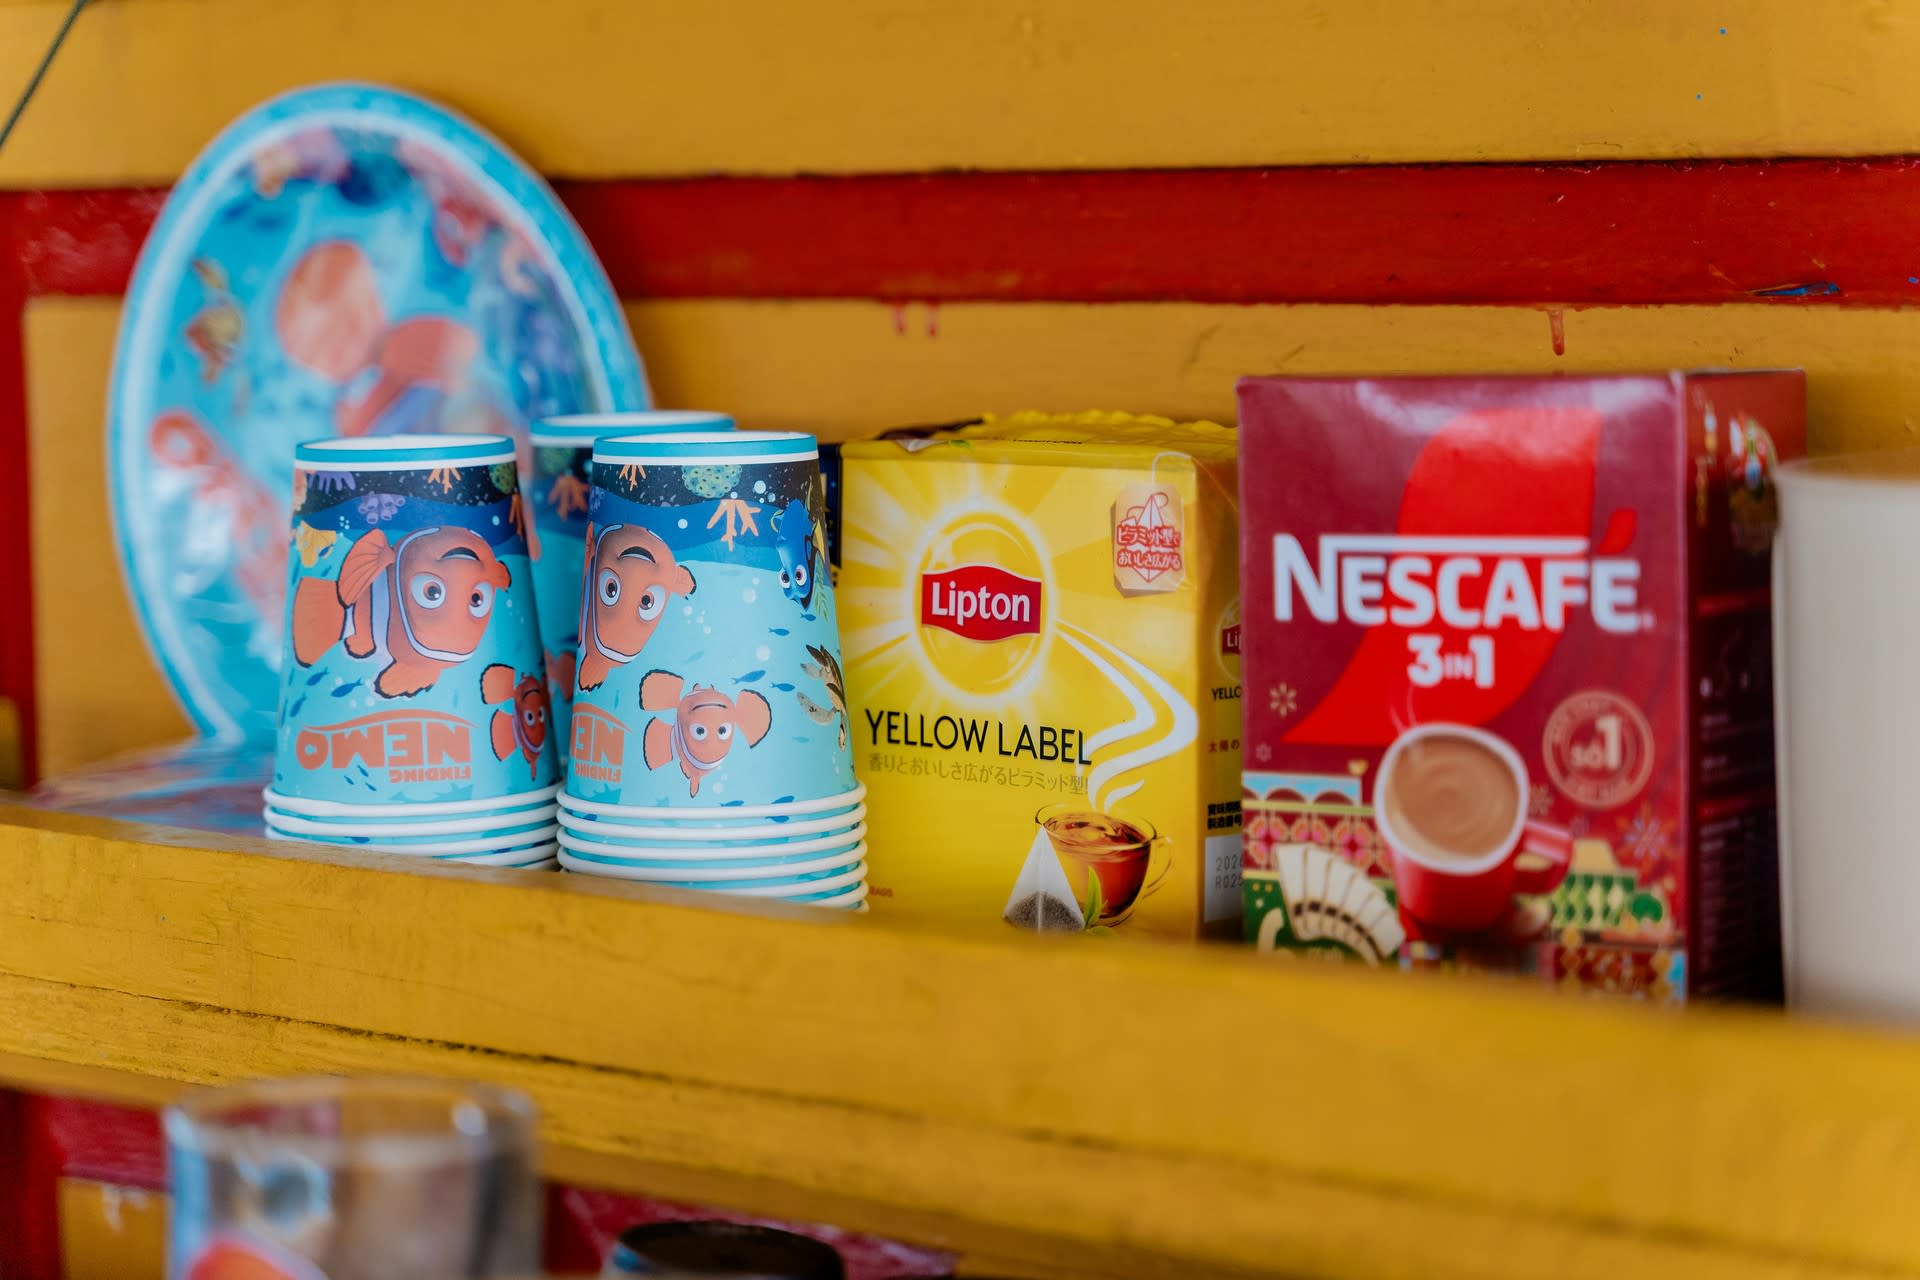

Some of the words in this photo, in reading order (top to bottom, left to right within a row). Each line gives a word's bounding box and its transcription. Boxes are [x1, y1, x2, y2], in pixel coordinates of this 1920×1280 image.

[1273, 509, 1641, 634] NESCAFÉ
[931, 580, 1031, 627] Lipton
[296, 721, 471, 770] NEMO
[865, 707, 989, 753] YELLOW
[998, 721, 1093, 766] LABEL
[389, 765, 471, 784] FINDING
